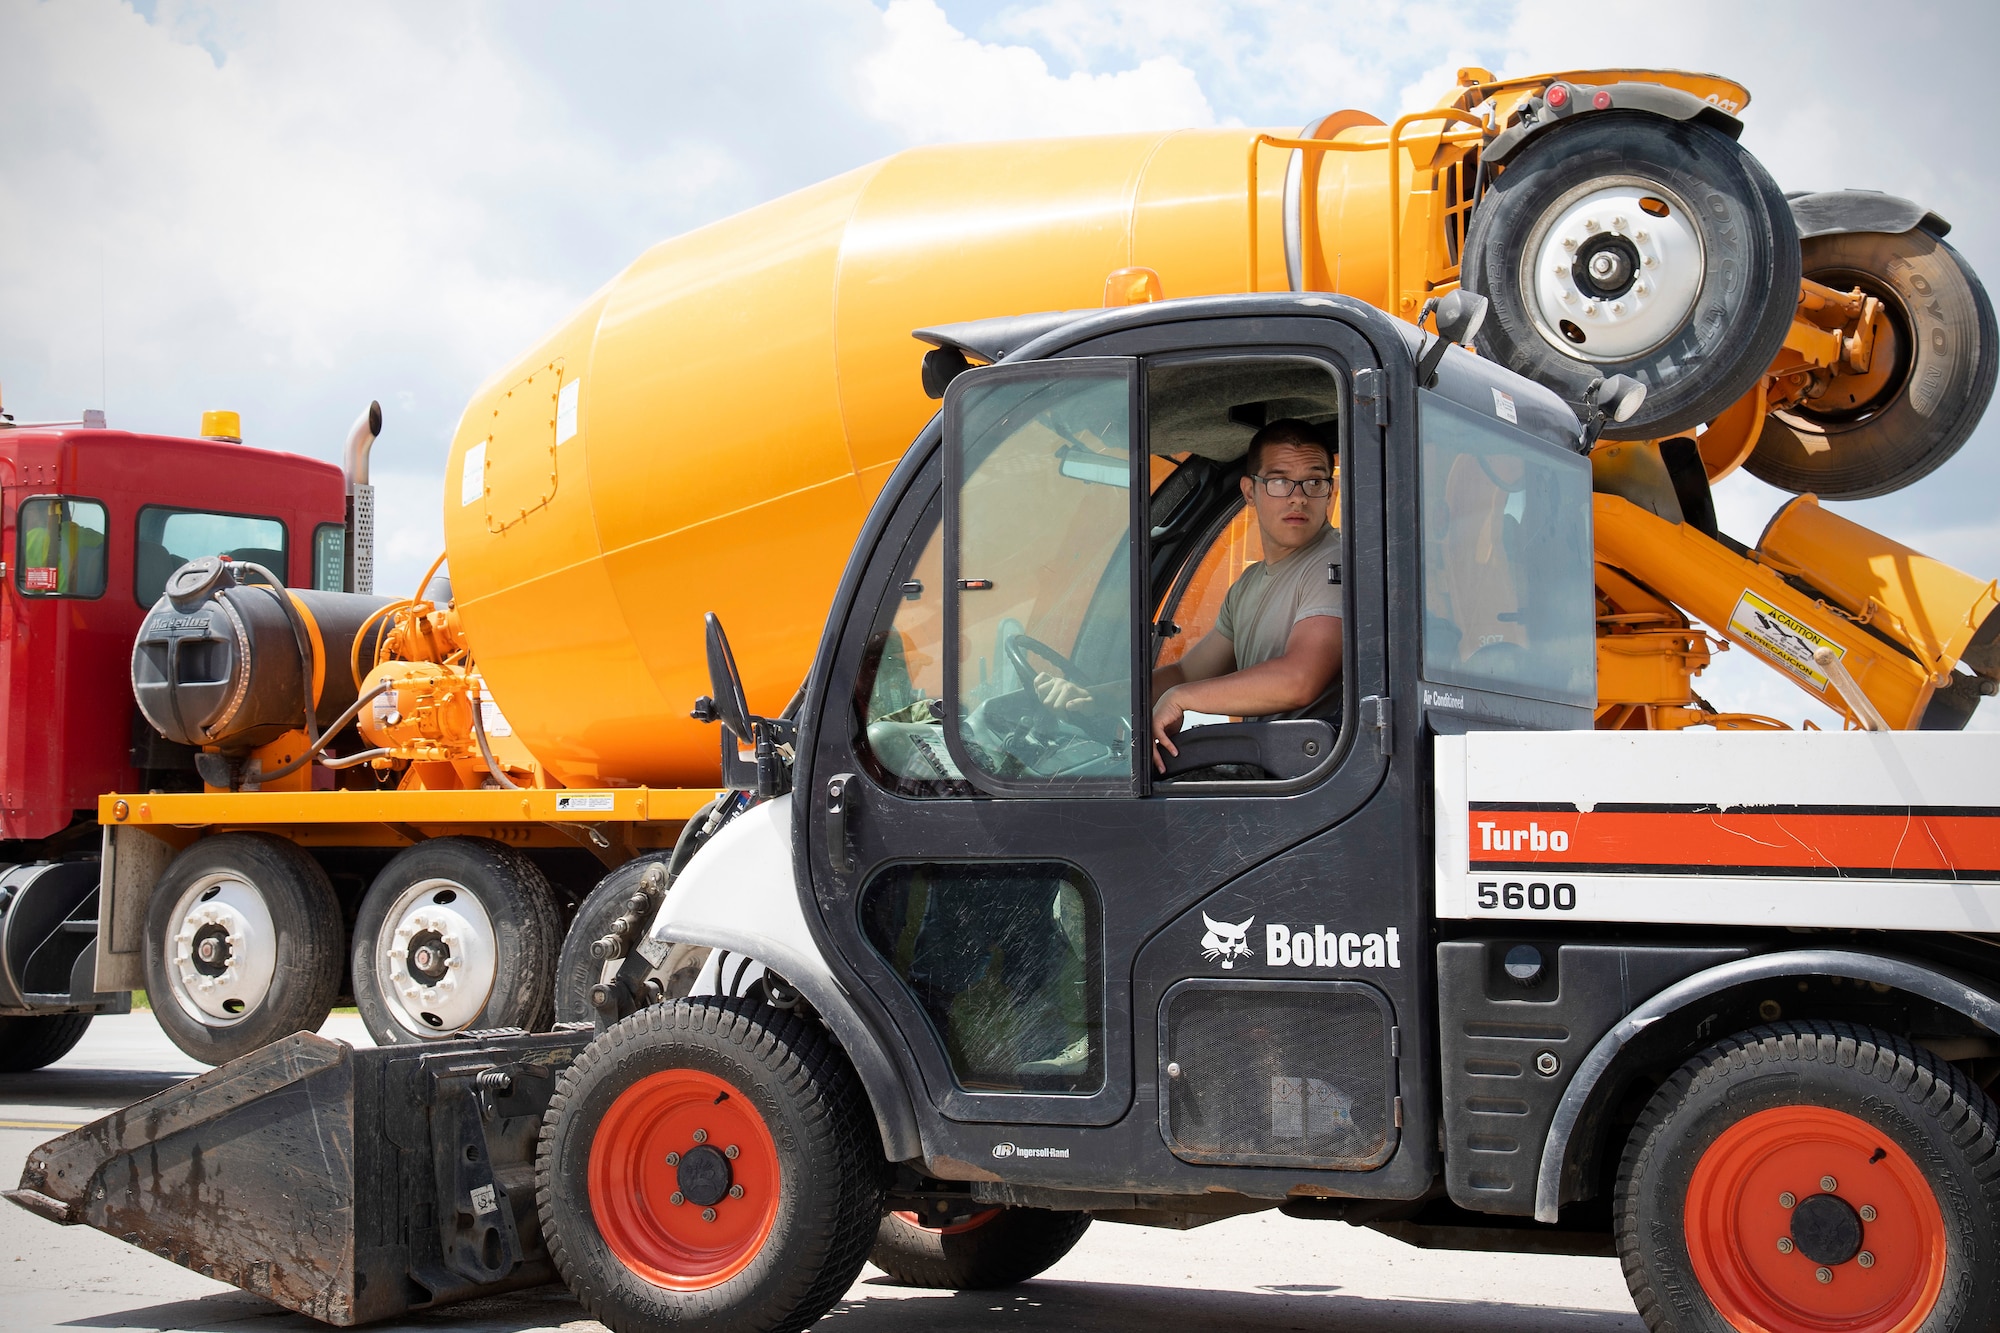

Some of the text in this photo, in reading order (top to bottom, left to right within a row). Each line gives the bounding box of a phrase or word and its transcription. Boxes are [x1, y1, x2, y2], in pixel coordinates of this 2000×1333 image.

[1886, 253, 1947, 357] TOYO
[1777, 613, 1821, 645] CAUTION
[1753, 635, 1813, 676] PRECAUCION
[1424, 690, 1432, 705] Air
[1477, 822, 1569, 852] Turbo
[1478, 882, 1576, 910] 5600
[1266, 924, 1401, 968] Bobcat
